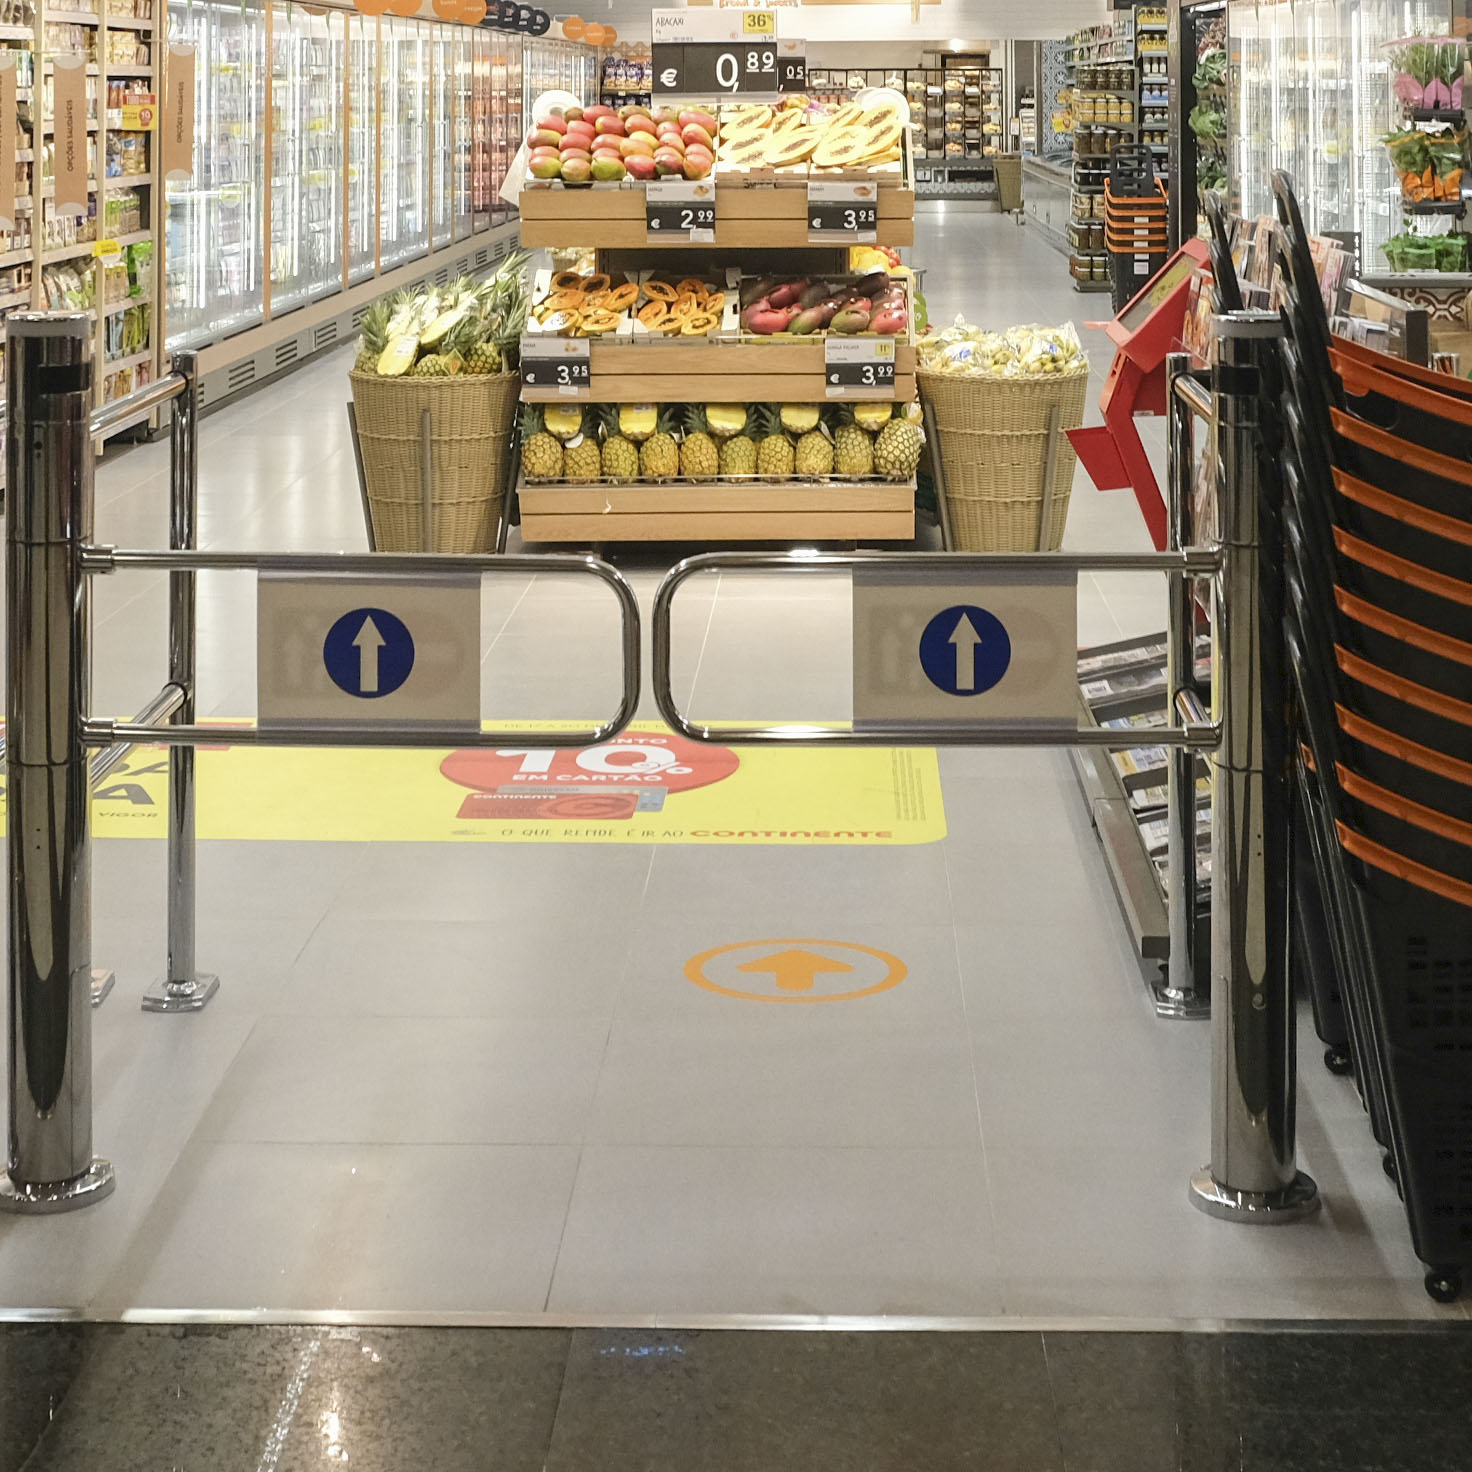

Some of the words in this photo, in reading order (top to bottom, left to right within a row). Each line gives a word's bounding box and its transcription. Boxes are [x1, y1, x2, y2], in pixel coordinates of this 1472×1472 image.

[660, 68, 677, 88] €
[715, 50, 775, 94] 0,89
[650, 218, 660, 229] €
[680, 209, 714, 230] 2,99
[812, 218, 822, 229] €
[512, 773, 551, 782] EM
[555, 773, 664, 783] CARTÃO
[689, 829, 894, 839] CONTINENTE
